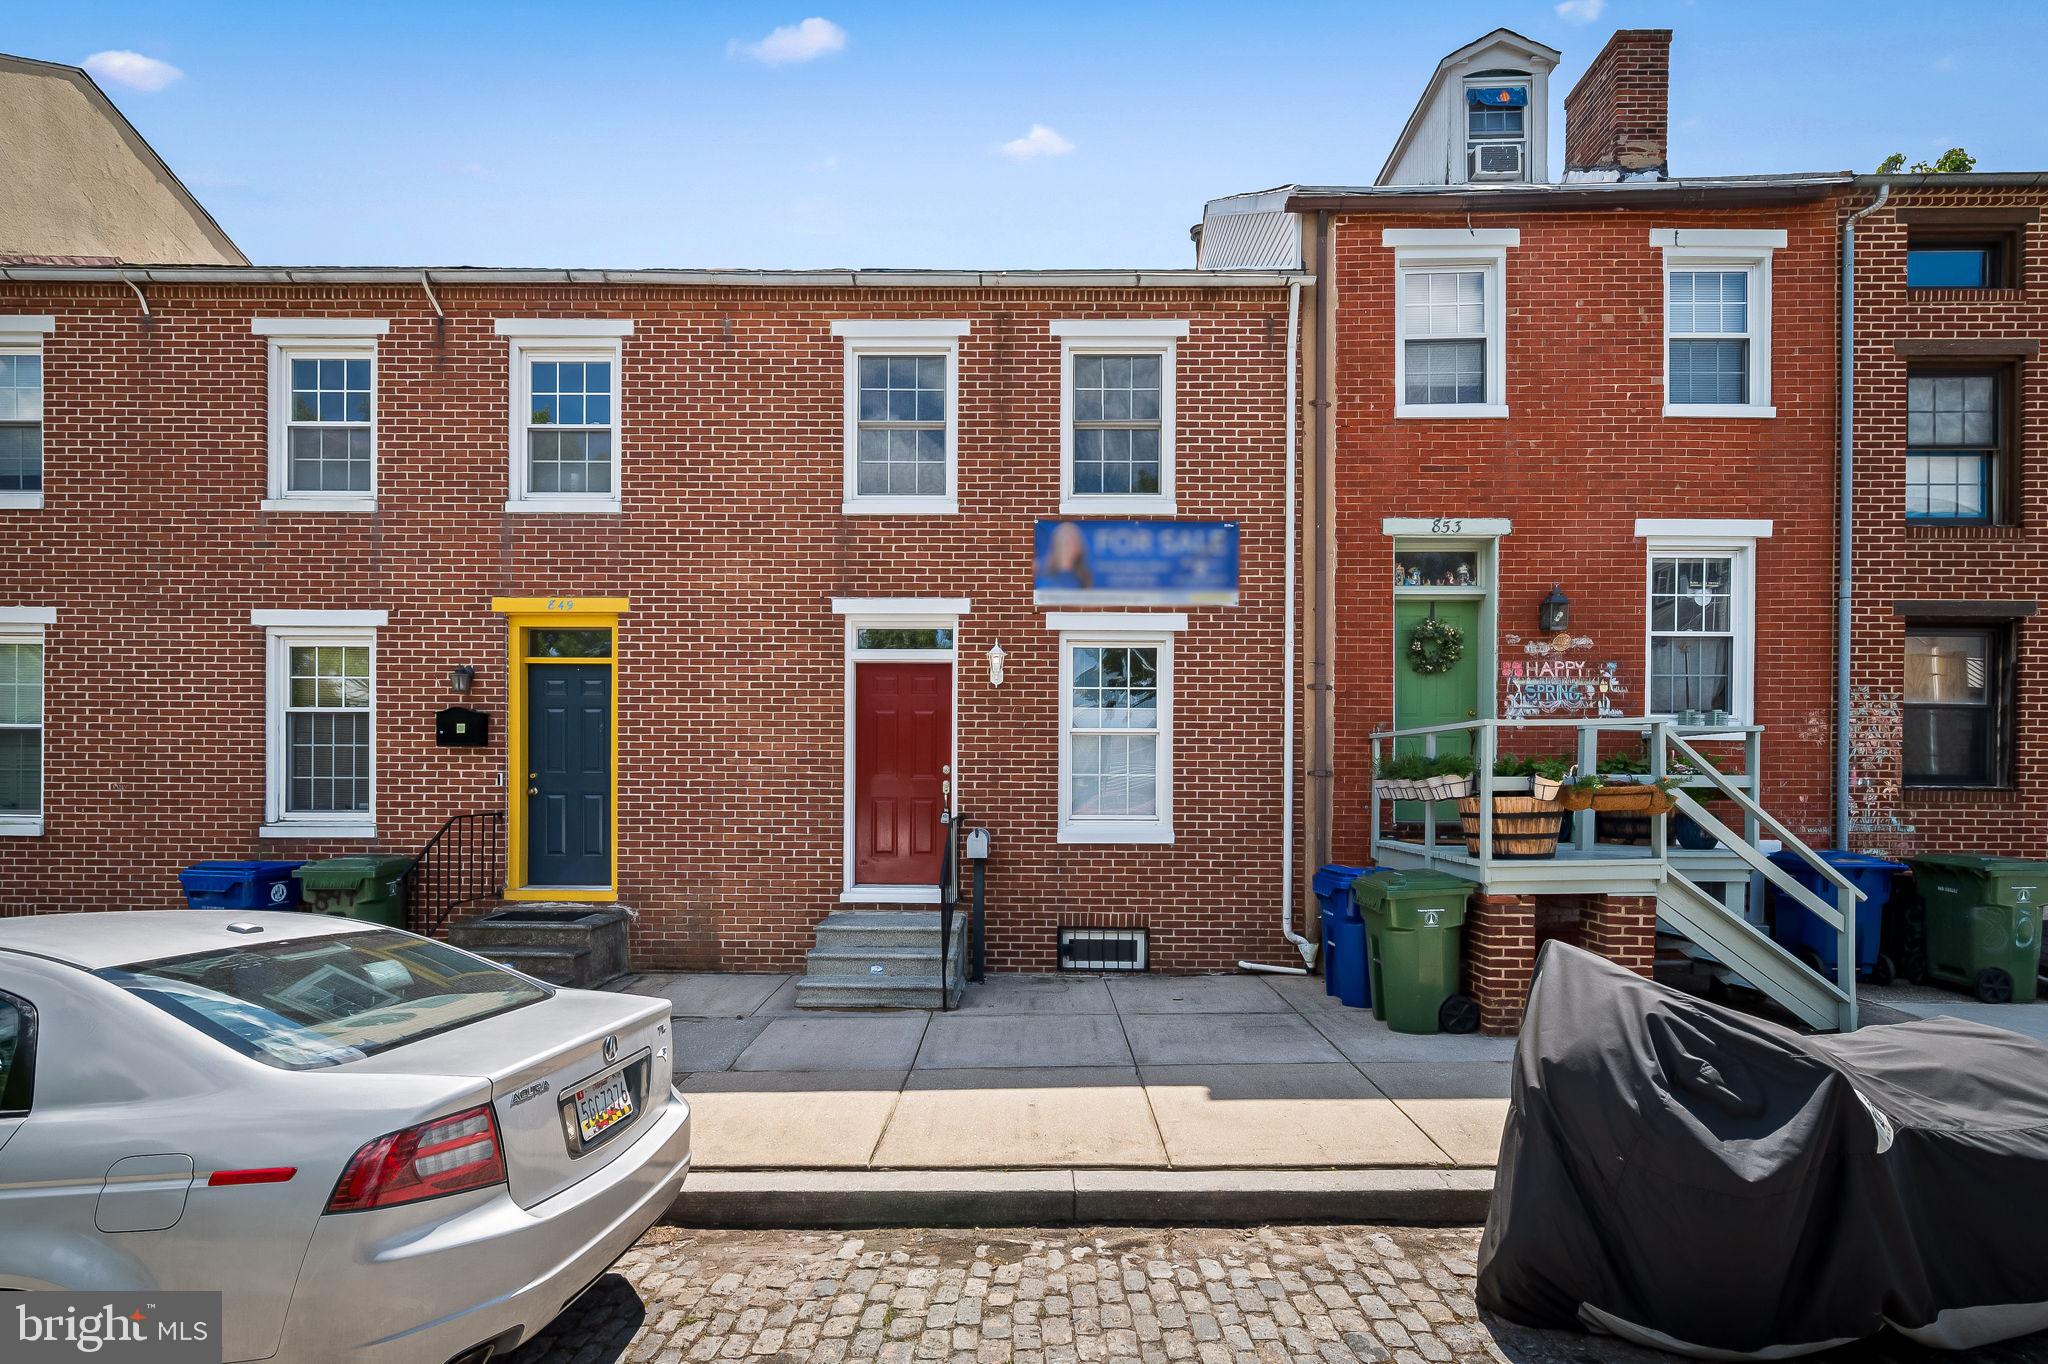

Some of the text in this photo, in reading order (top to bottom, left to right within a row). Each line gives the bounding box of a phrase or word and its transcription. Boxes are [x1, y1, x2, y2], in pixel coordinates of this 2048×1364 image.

[1431, 518, 1463, 533] 853
[547, 600, 574, 611] 849
[1526, 661, 1585, 678] HAPPY
[1525, 684, 1583, 702] SPRING
[510, 1080, 550, 1107] ACURA
